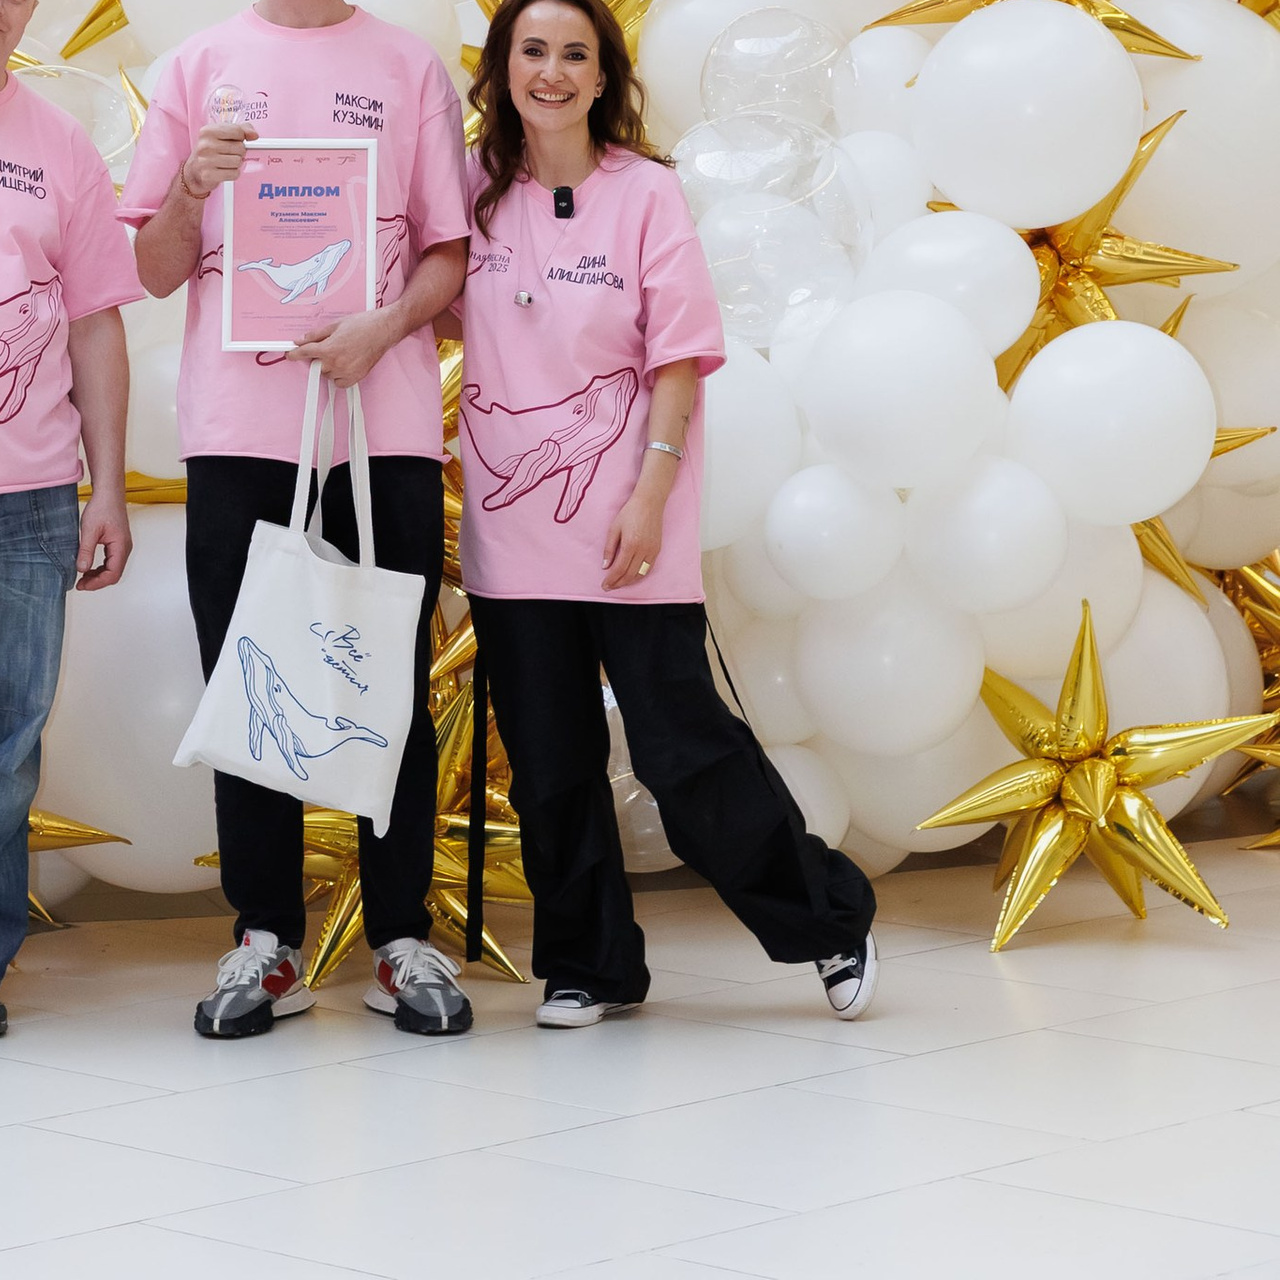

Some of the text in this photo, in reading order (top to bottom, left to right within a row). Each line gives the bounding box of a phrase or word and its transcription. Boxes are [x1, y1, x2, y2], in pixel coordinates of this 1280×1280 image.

[335, 92, 383, 114] МАКСИМ
[244, 110, 268, 121] 2025
[333, 109, 384, 132] КУЗЬМИН
[258, 183, 340, 199] Диплом
[576, 255, 607, 270] ДИНА
[546, 267, 624, 291] АЛИШПАНОВА
